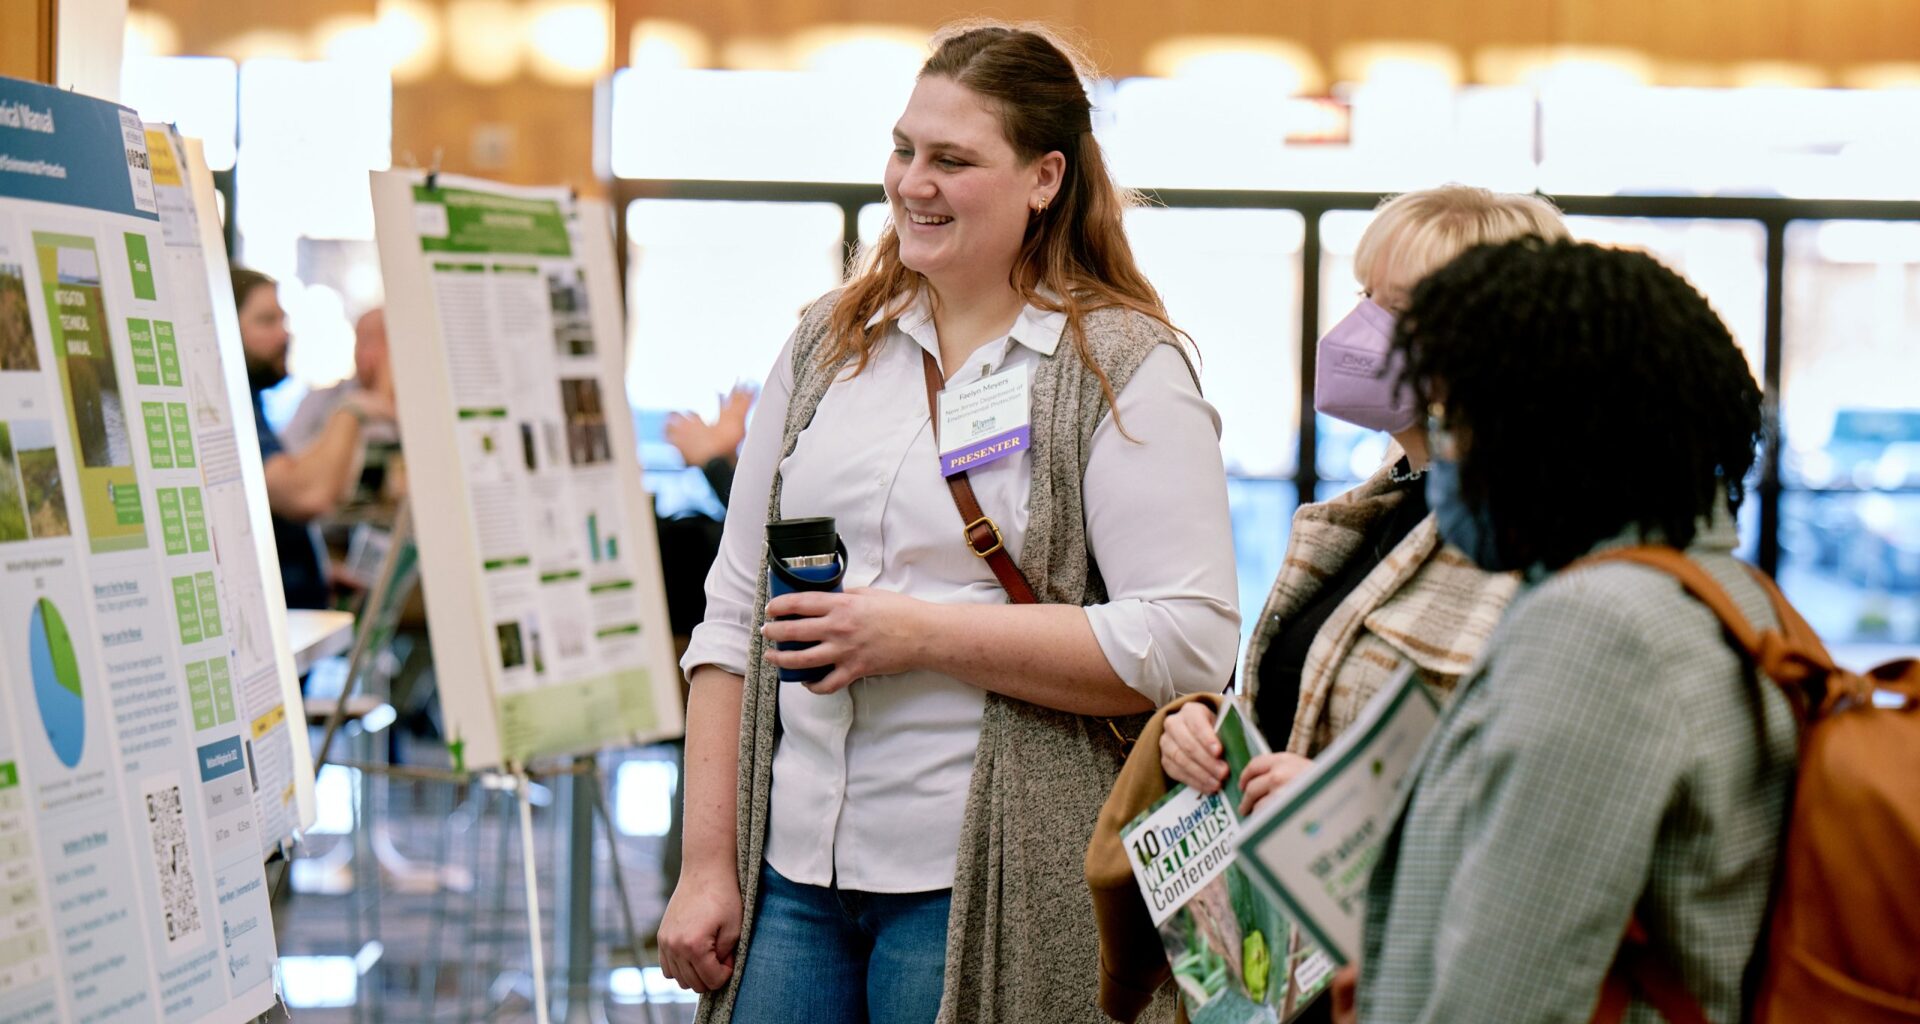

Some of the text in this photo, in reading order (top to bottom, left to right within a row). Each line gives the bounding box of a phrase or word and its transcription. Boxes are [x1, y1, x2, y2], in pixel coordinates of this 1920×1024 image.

[983, 378, 1009, 392] Meyers
[950, 436, 1020, 469] PRESENTER
[1133, 829, 1160, 866] 10
[1142, 806, 1231, 893] WETLANDS
